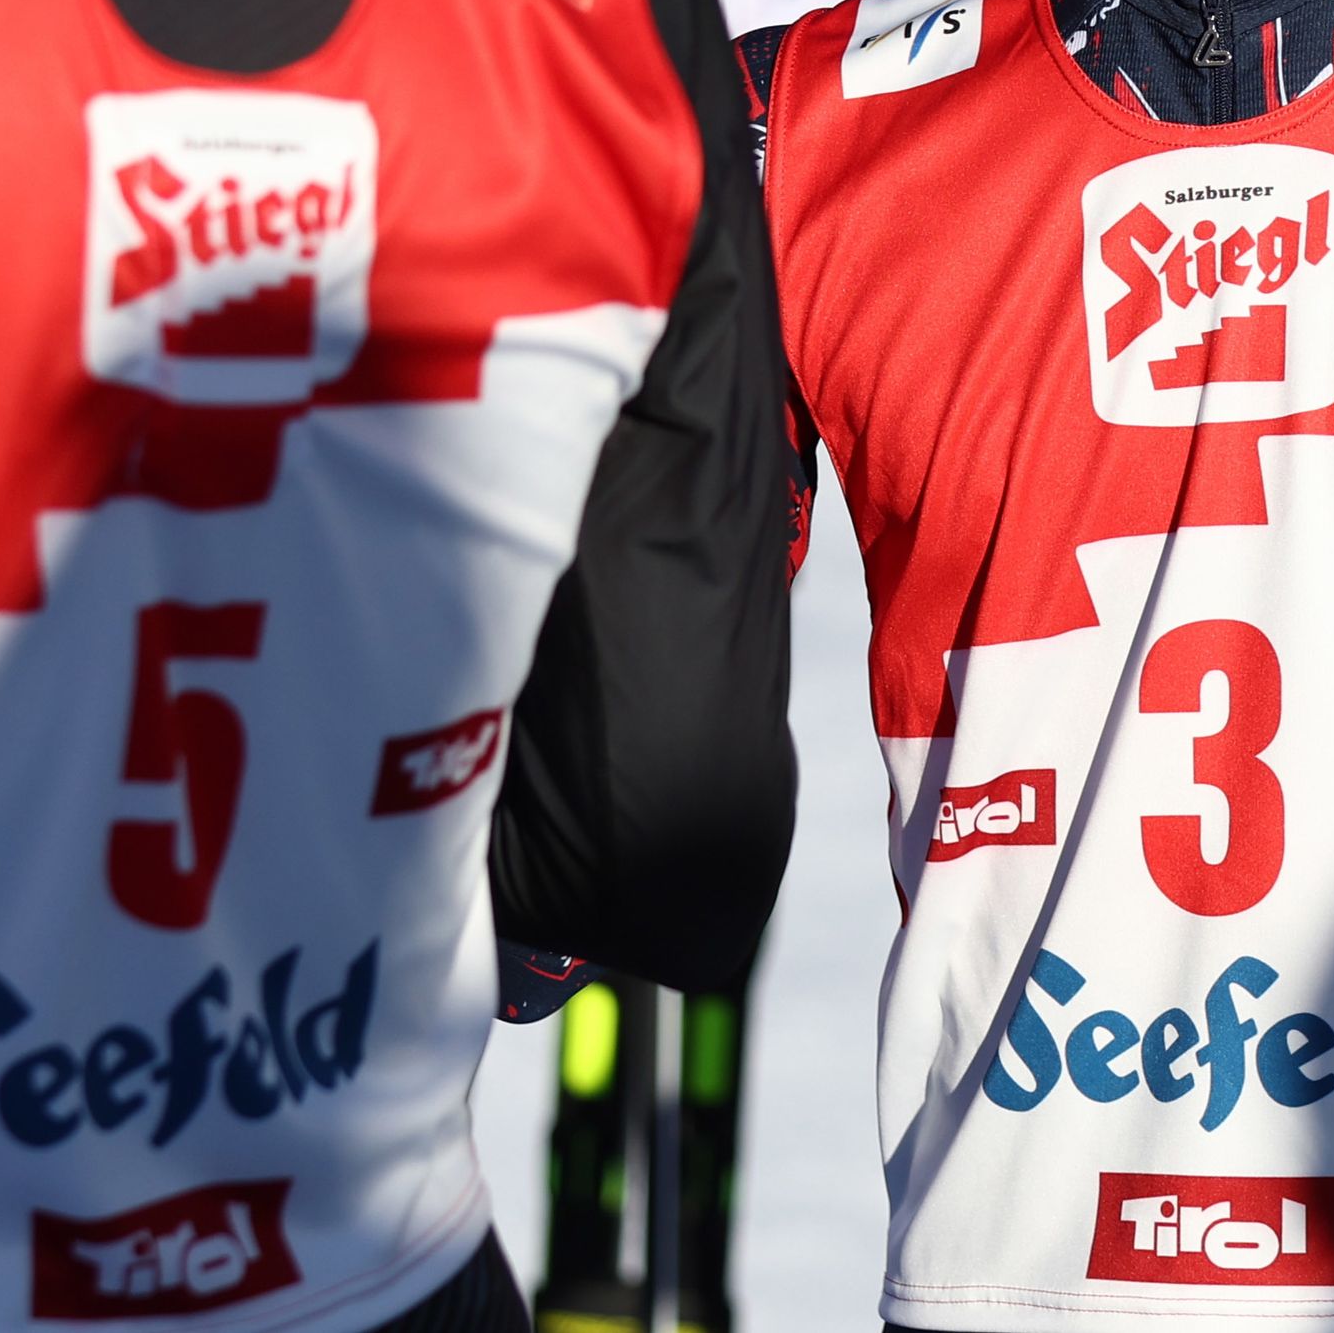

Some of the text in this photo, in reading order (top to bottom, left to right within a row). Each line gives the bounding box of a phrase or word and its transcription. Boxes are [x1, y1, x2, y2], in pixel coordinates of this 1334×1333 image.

[111, 156, 355, 310] Stiegl
[1164, 185, 1274, 205] Salzburger
[1100, 189, 1331, 363] Stiegl
[107, 601, 268, 931] 5
[933, 783, 1037, 844] irol
[1139, 618, 1285, 917] 3
[74, 1200, 262, 1299] Tirol
[1120, 1194, 1307, 1271] Tirol
